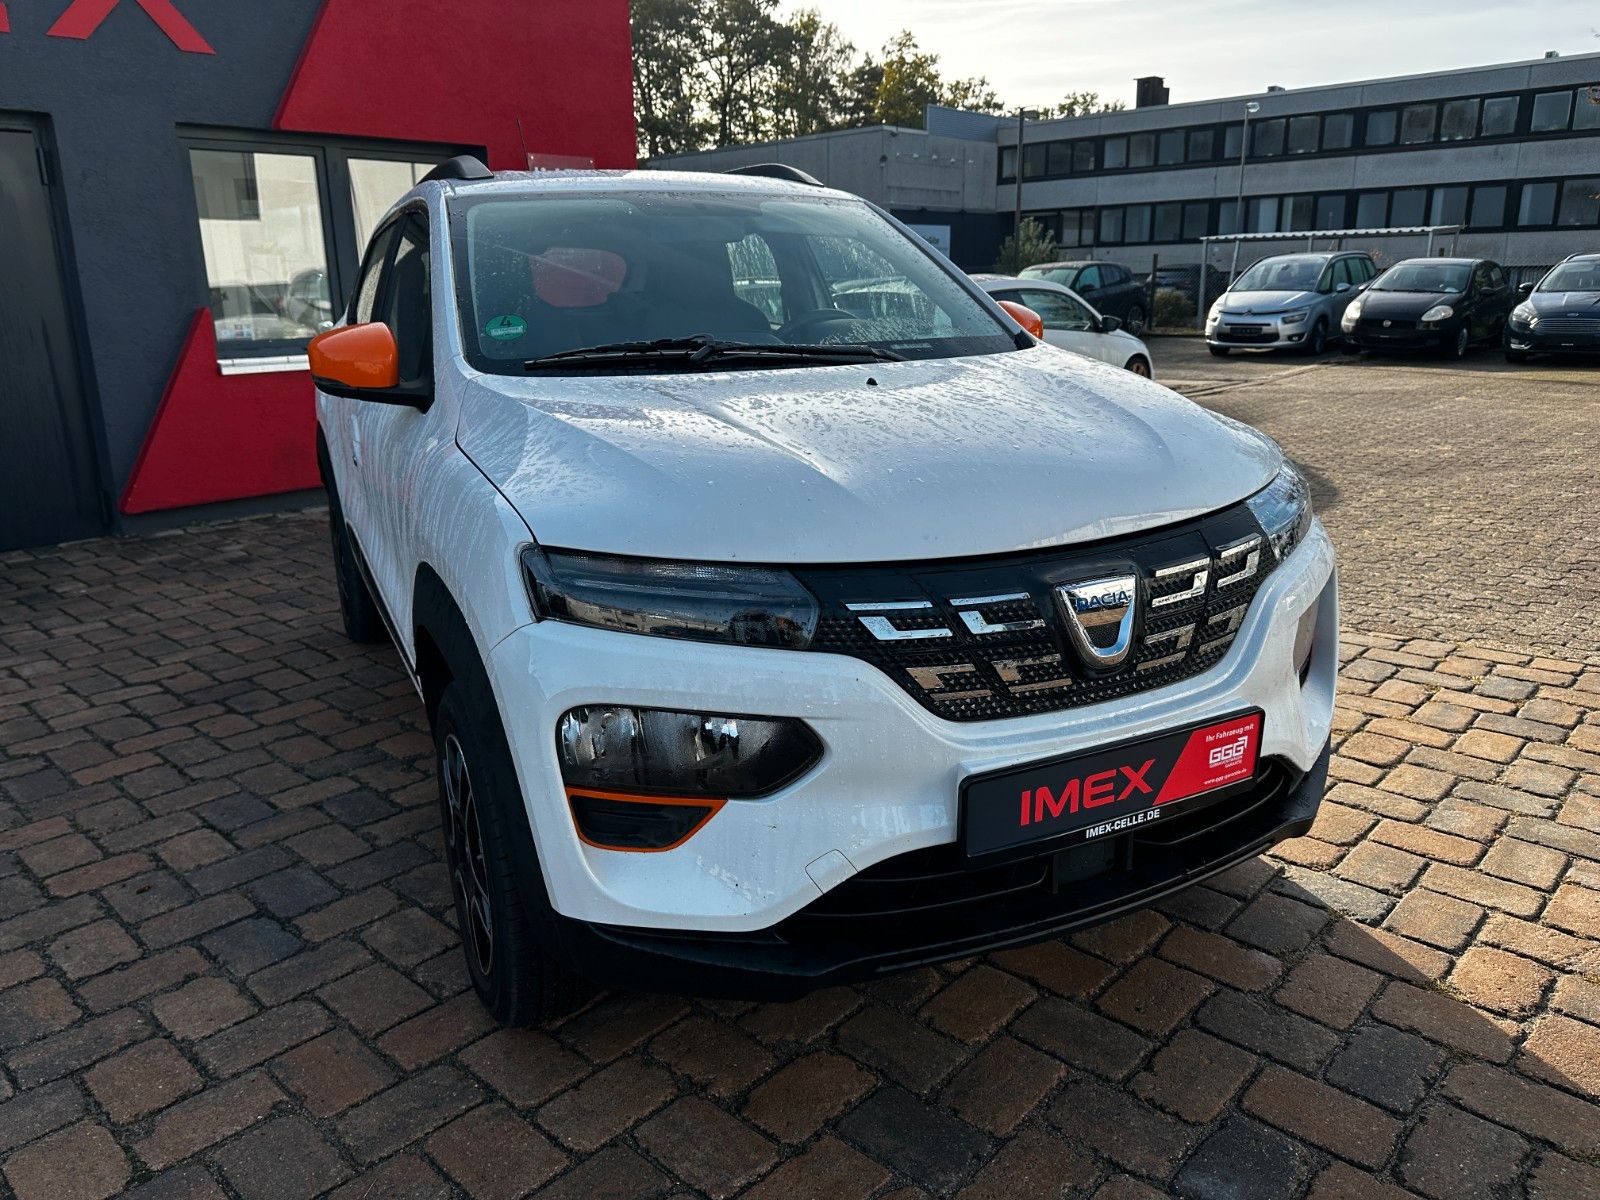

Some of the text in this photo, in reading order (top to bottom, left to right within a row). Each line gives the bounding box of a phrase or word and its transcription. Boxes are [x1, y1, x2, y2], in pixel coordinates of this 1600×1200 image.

[500, 315, 513, 328] 4
[1076, 590, 1129, 612] DACIA
[1205, 723, 1254, 743] Ihr Fahrzeug mit
[1209, 737, 1247, 764] GGG
[1020, 758, 1156, 827] IMEX
[1085, 808, 1161, 839] IMEX-CELLE.DE
